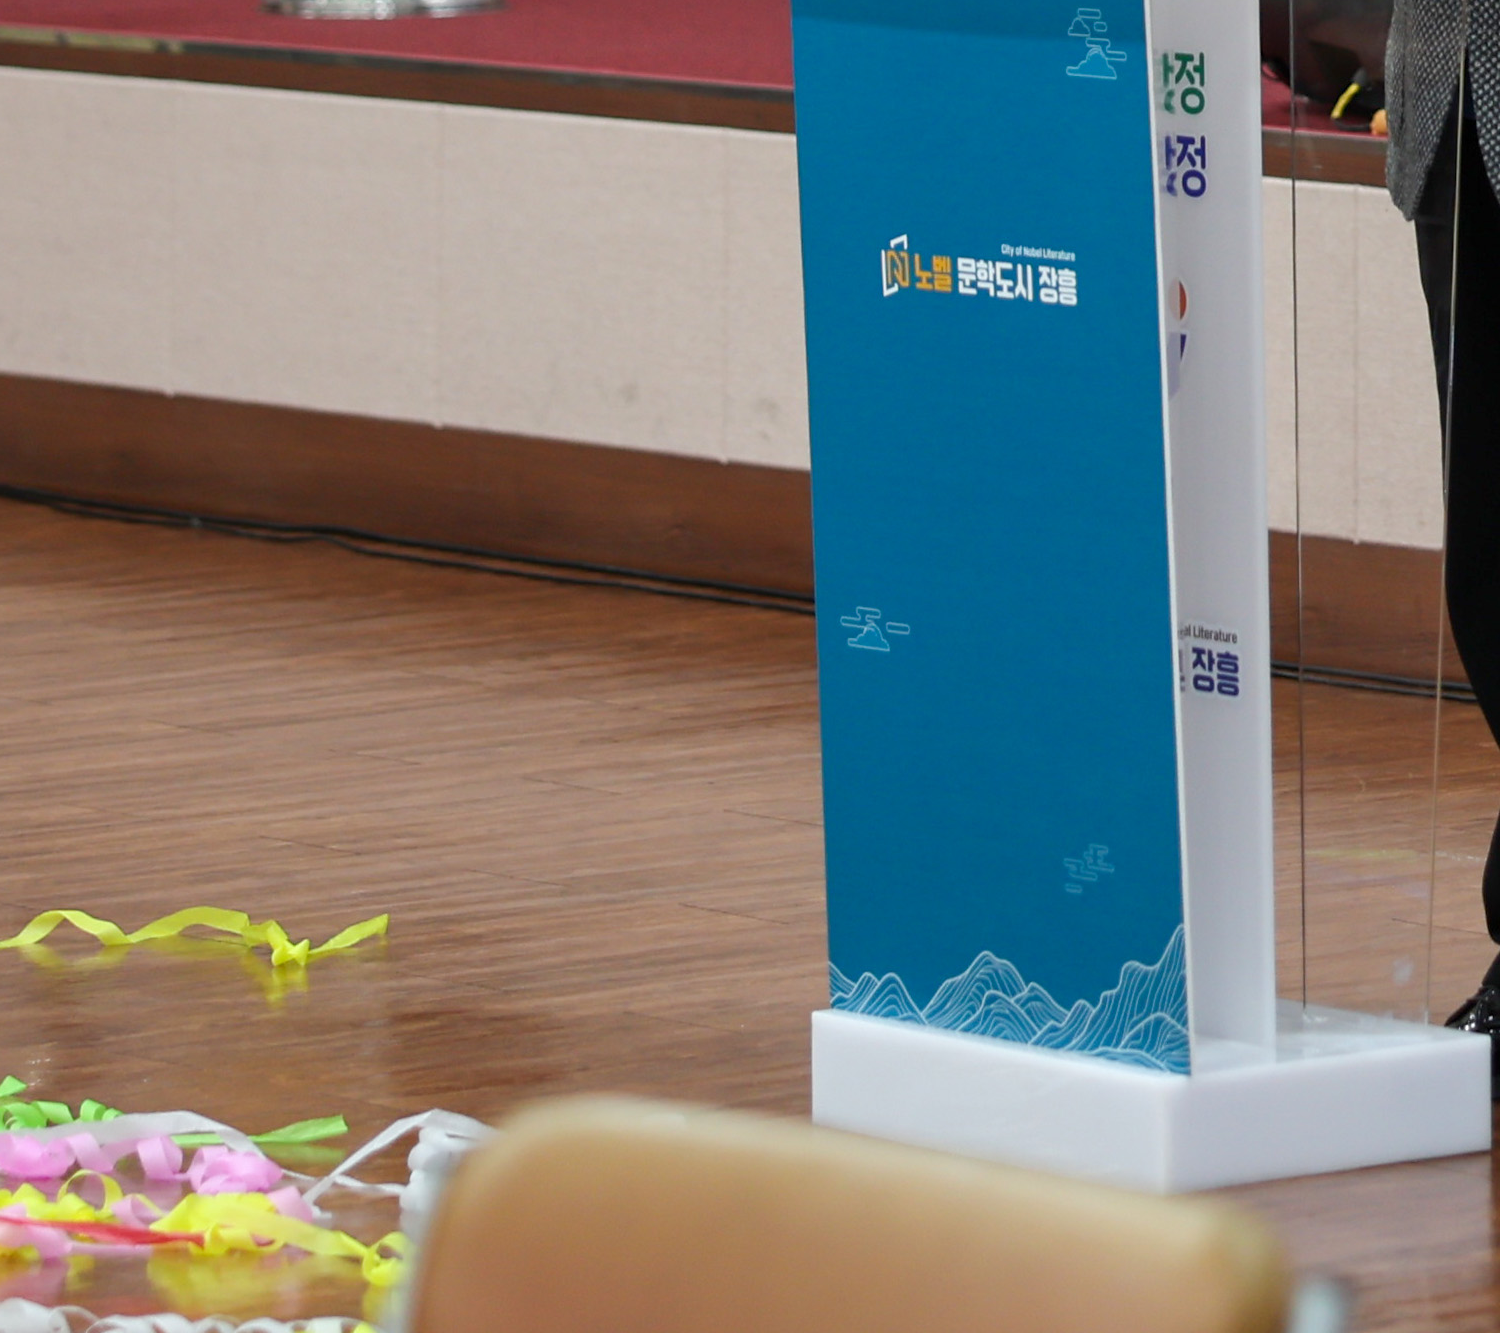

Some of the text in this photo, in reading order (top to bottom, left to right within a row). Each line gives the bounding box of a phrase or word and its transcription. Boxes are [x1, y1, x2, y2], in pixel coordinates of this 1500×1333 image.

[914, 253, 953, 293] 노벨
[957, 256, 1035, 302] 문학도시
[1038, 265, 1078, 307] 장흥
[1191, 646, 1240, 696] 장흥
